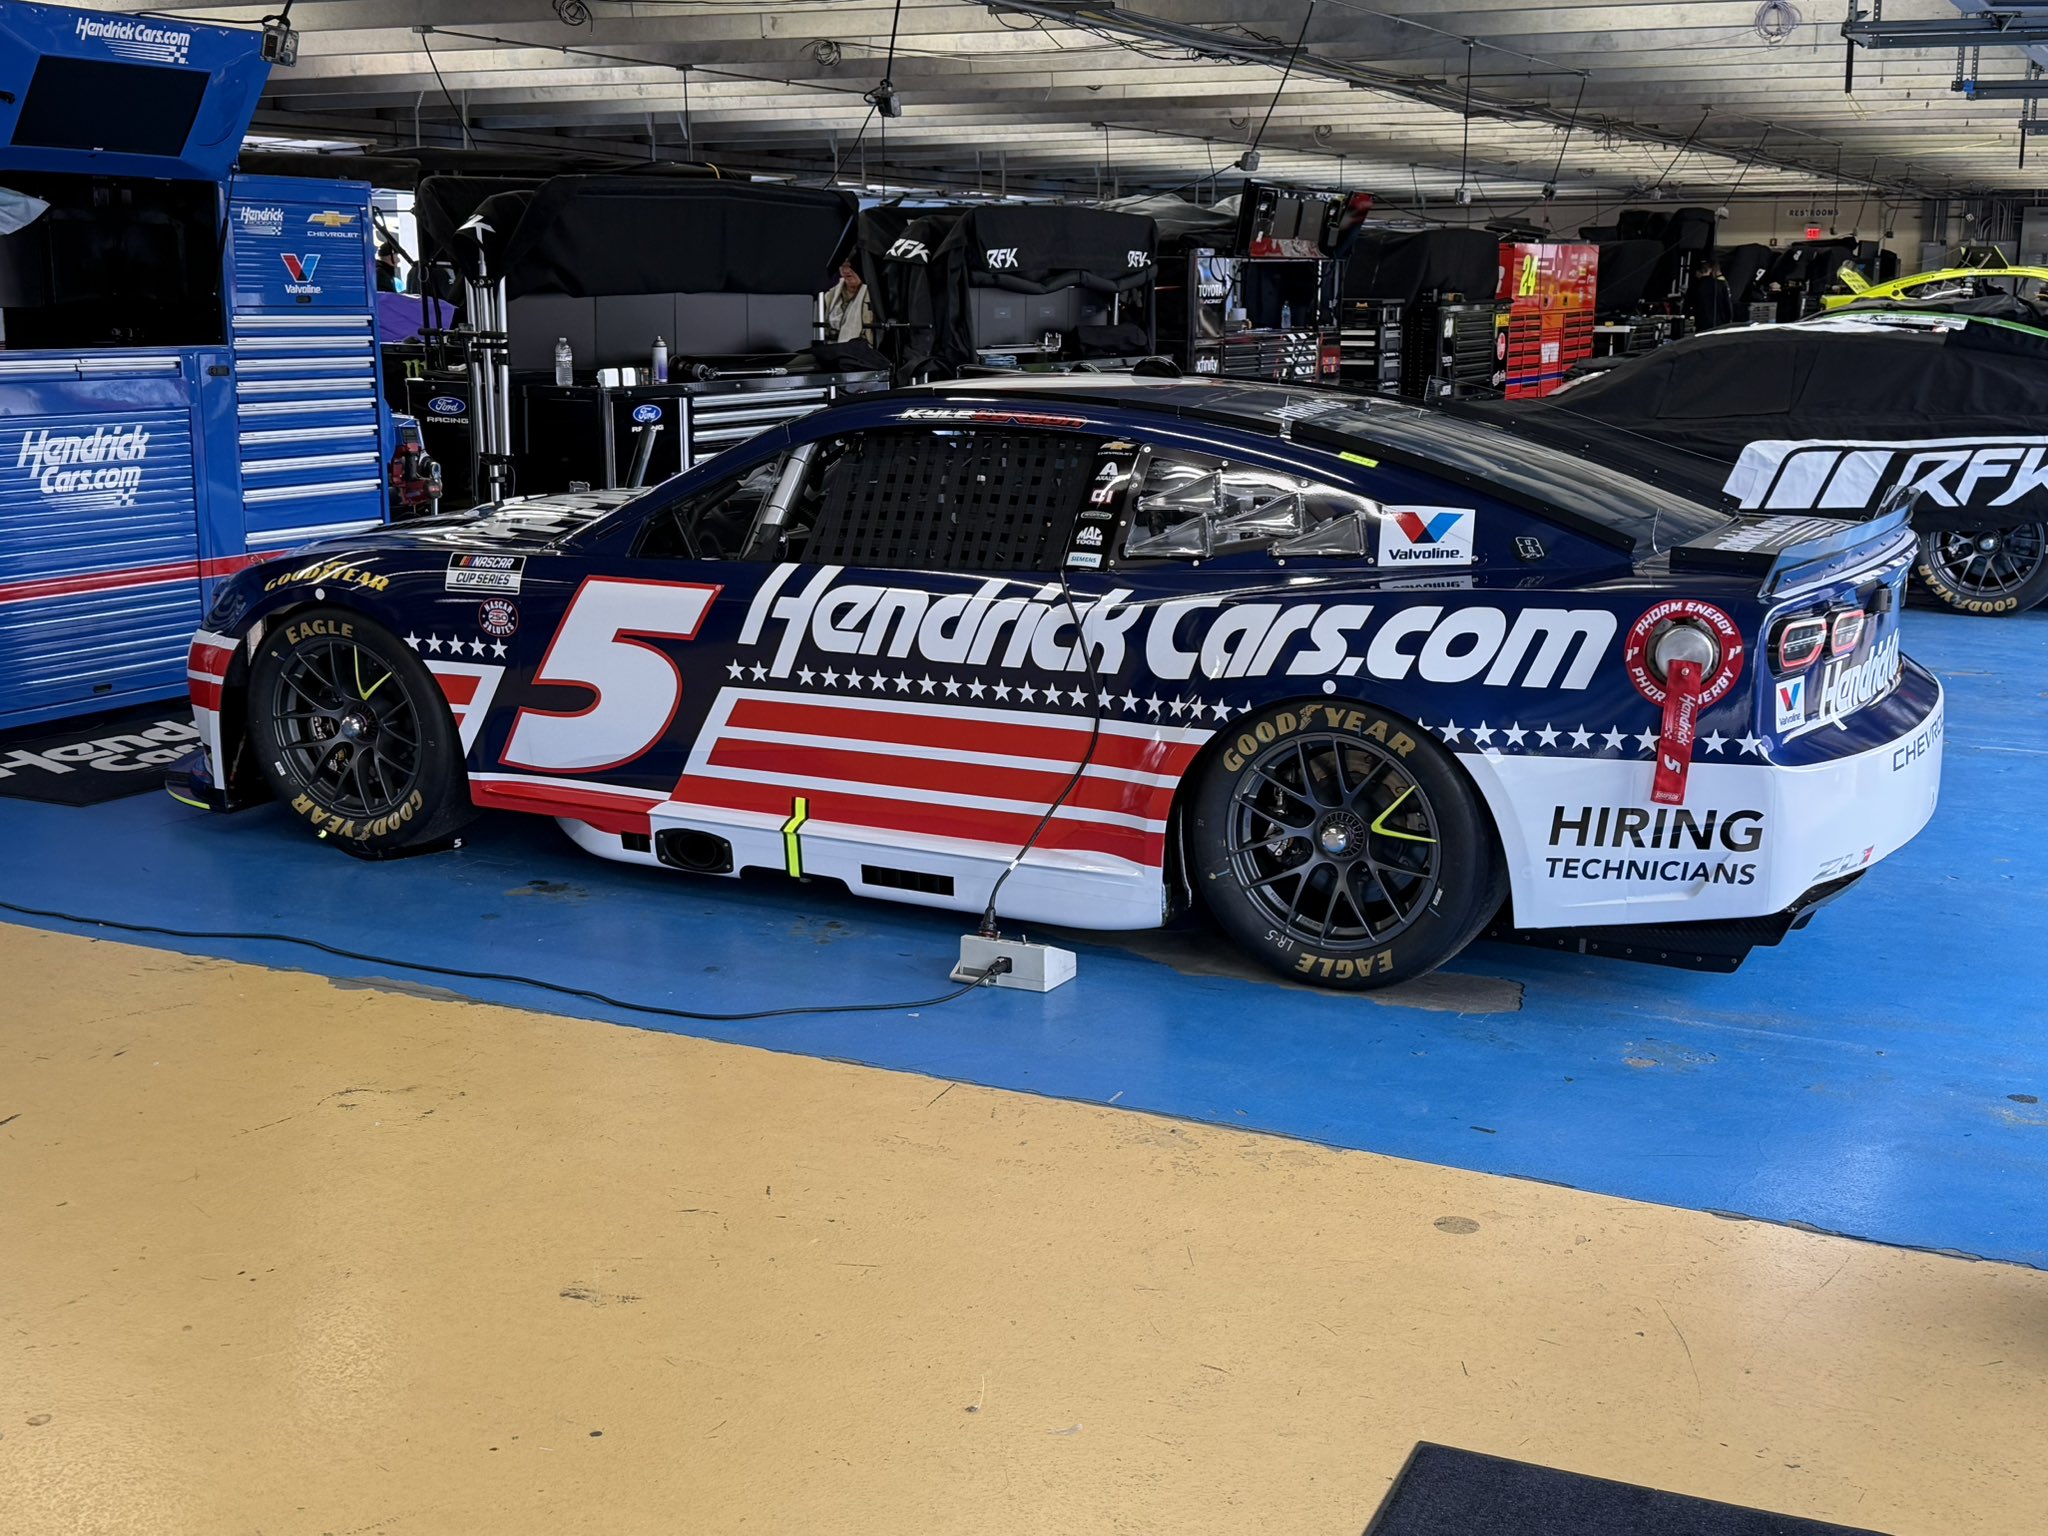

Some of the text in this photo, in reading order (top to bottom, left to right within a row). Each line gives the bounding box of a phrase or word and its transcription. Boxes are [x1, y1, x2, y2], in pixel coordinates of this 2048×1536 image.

[76, 17, 190, 46] HendrickCars.com
[241, 206, 284, 224] Hendrick
[1789, 209, 1839, 217] RESTROOMS
[886, 238, 931, 264] RFK
[987, 248, 1018, 268] RFK
[1128, 251, 1151, 267] RFK
[1519, 255, 1539, 296] 24
[284, 285, 322, 294] Valvoline
[1198, 284, 1224, 297] TOYOTA
[430, 399, 461, 412] Ford
[638, 407, 657, 420] Ford
[427, 416, 469, 424] RACING
[17, 425, 150, 479] Hendrick
[40, 466, 142, 494] Cars.com
[1077, 526, 1102, 540] MAC
[471, 556, 515, 569] NASCAR
[1071, 556, 1097, 564] SIEMENS
[1389, 547, 1463, 560] Valvoline
[456, 572, 511, 585] CUP SERIES
[484, 601, 513, 614] NASCAR
[483, 620, 515, 634] SALUTES
[738, 562, 1618, 690] HendrickCars.com
[1635, 601, 1736, 637] PHORM ENERGY
[285, 620, 354, 645] EAGLE
[498, 575, 723, 773] 5
[1632, 666, 1667, 704] PHOR
[1677, 692, 1696, 747] Hendrick
[1663, 753, 1681, 775] 5
[1549, 805, 1765, 852] HIRING
[1546, 857, 1757, 886] TECHNICIANS
[1812, 845, 1876, 882] ZL1
[1264, 929, 1295, 952] LR-5
[1295, 949, 1394, 978] EAGLE
